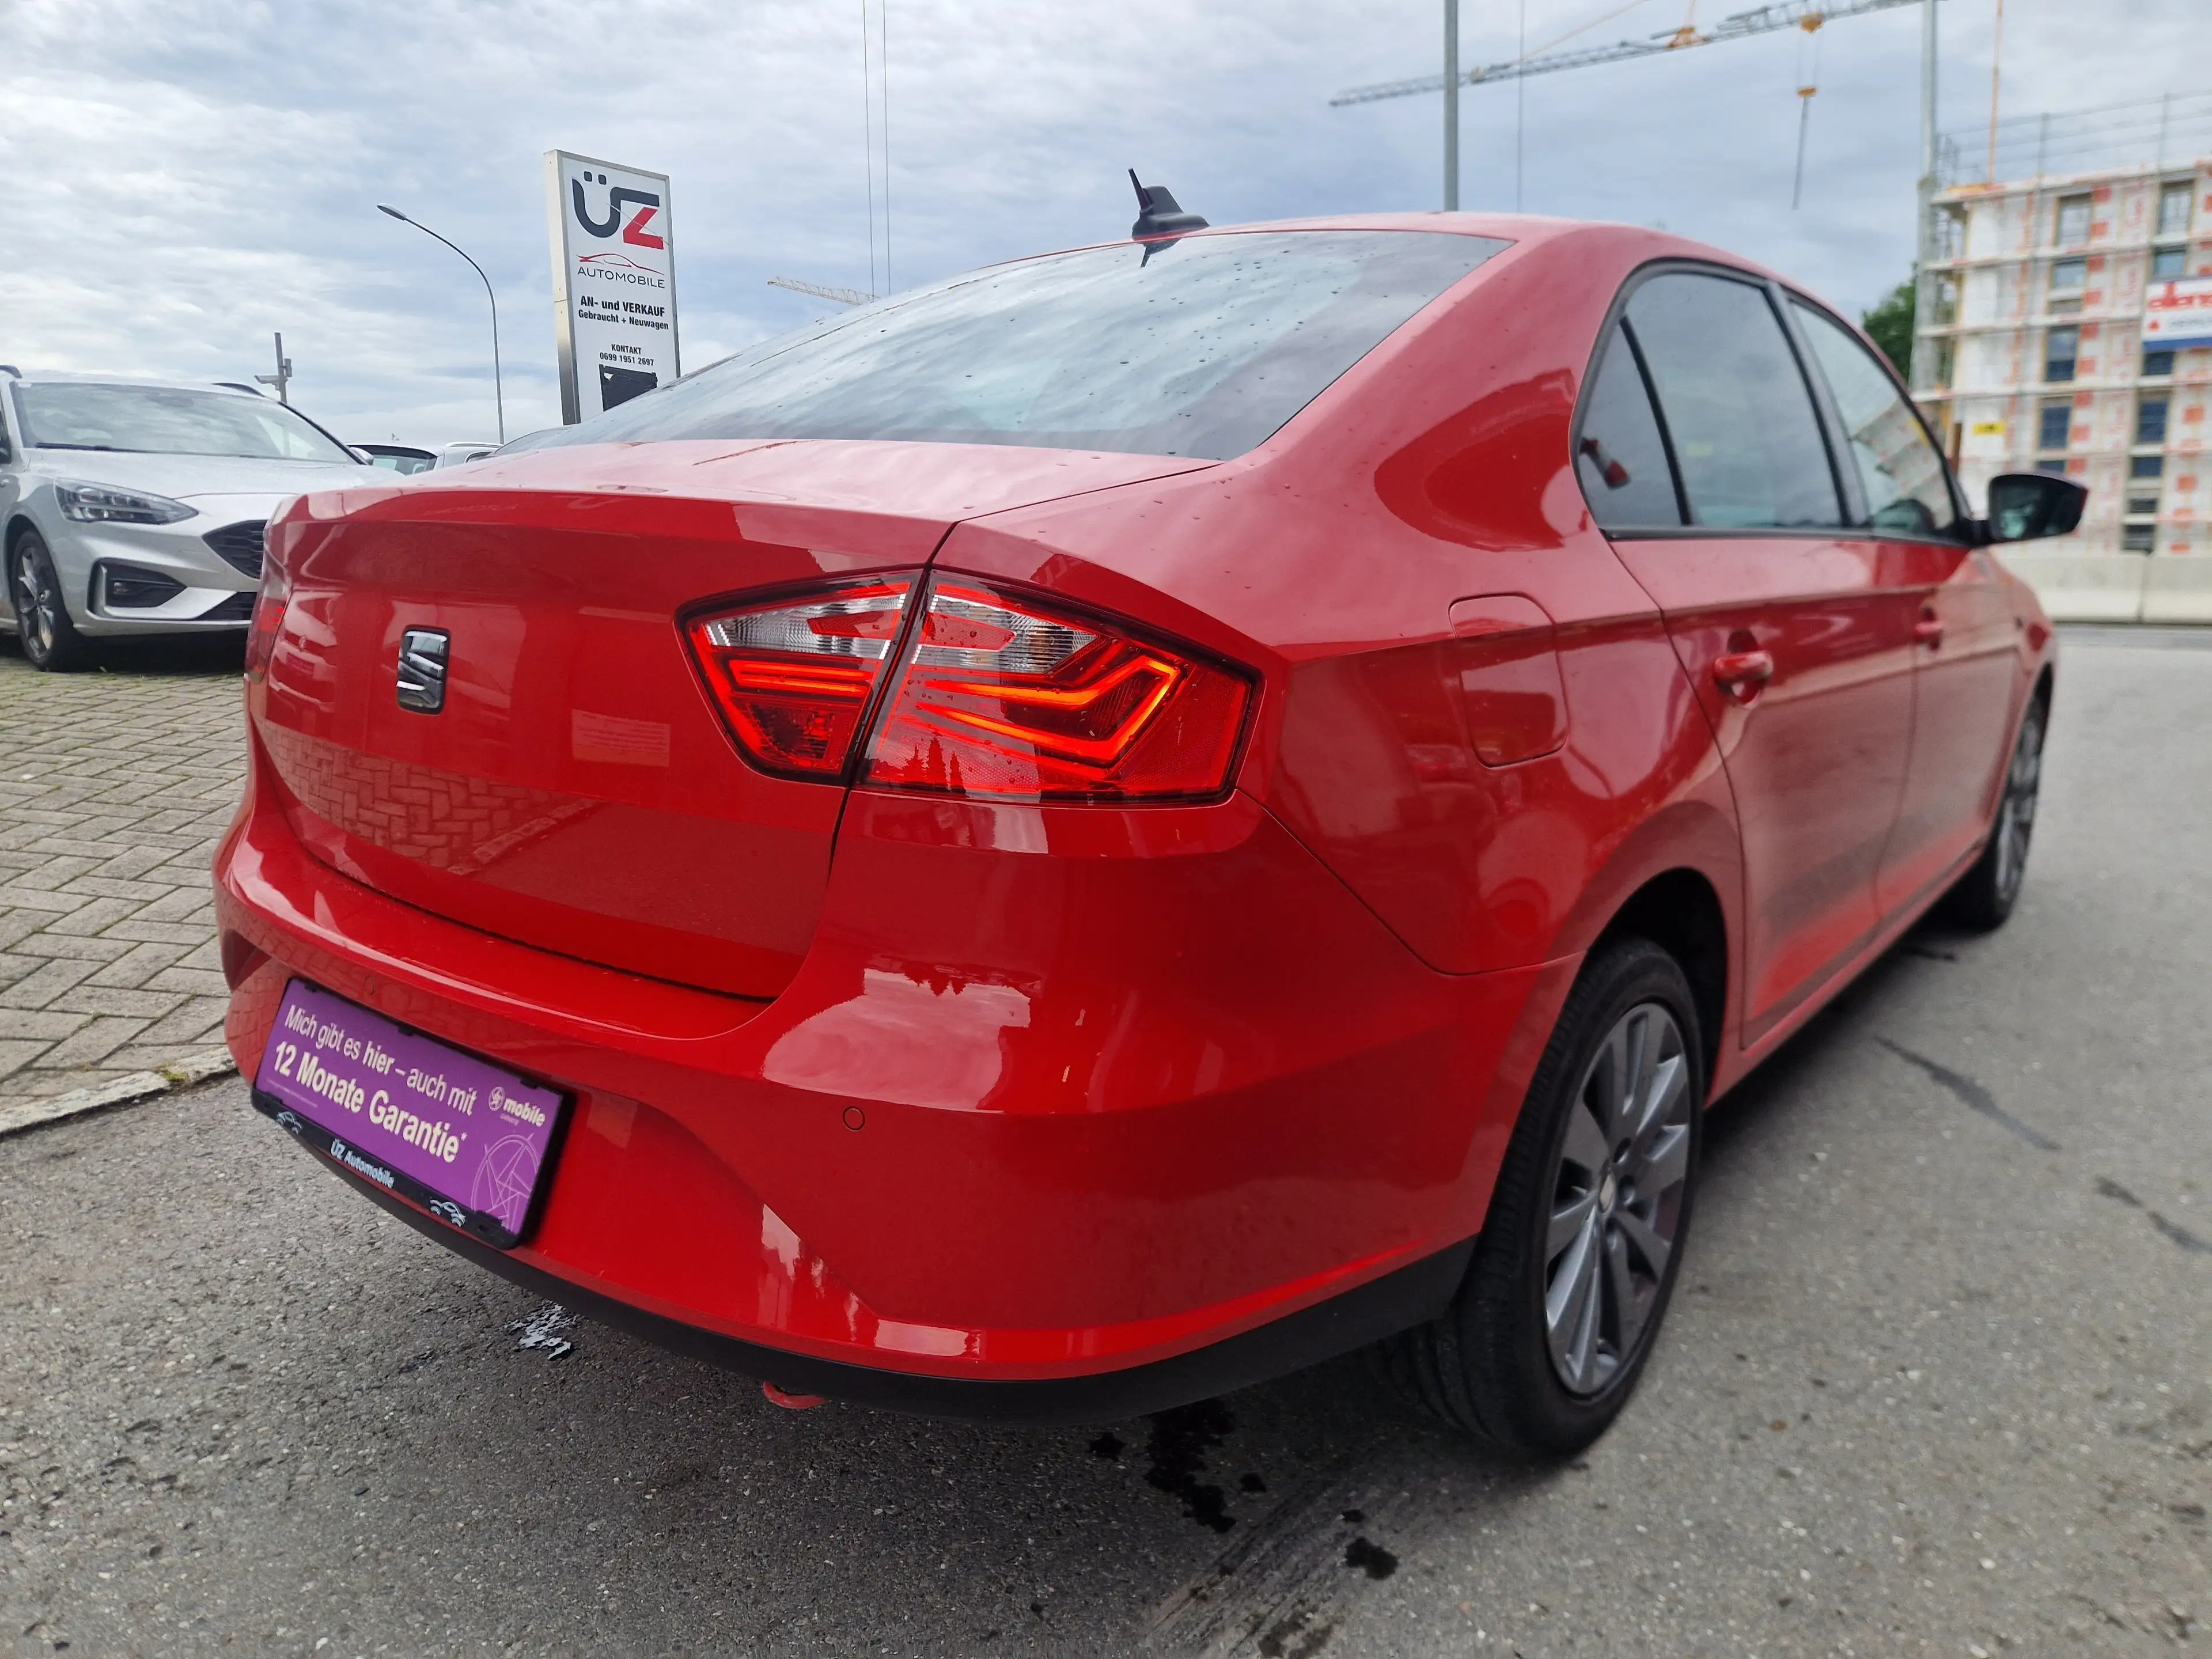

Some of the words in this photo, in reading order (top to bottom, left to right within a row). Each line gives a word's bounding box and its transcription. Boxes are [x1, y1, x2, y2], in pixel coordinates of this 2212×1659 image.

[572, 171, 664, 250] ÜZ
[577, 267, 665, 289] AUTOMOBILE
[578, 309, 619, 323] Gebraucht
[629, 316, 669, 330] Neuwagen
[581, 296, 598, 307] AN-
[602, 301, 620, 310] und
[623, 301, 665, 317] VERKAUF
[600, 352, 617, 361] 0699
[619, 355, 635, 364] 1951
[638, 357, 654, 366] 2697
[611, 343, 642, 355] KONTAKT
[285, 1005, 317, 1038] Mich
[316, 1022, 345, 1051] gibt
[343, 1039, 362, 1060] es
[362, 1040, 396, 1076] hier
[406, 1068, 447, 1105] auch
[446, 1085, 478, 1116] mit
[274, 1040, 297, 1077] 12
[296, 1051, 365, 1114] Monate
[503, 1097, 546, 1127] mobile
[331, 1138, 346, 1160] ÜZ
[344, 1150, 395, 1189] Automobile
